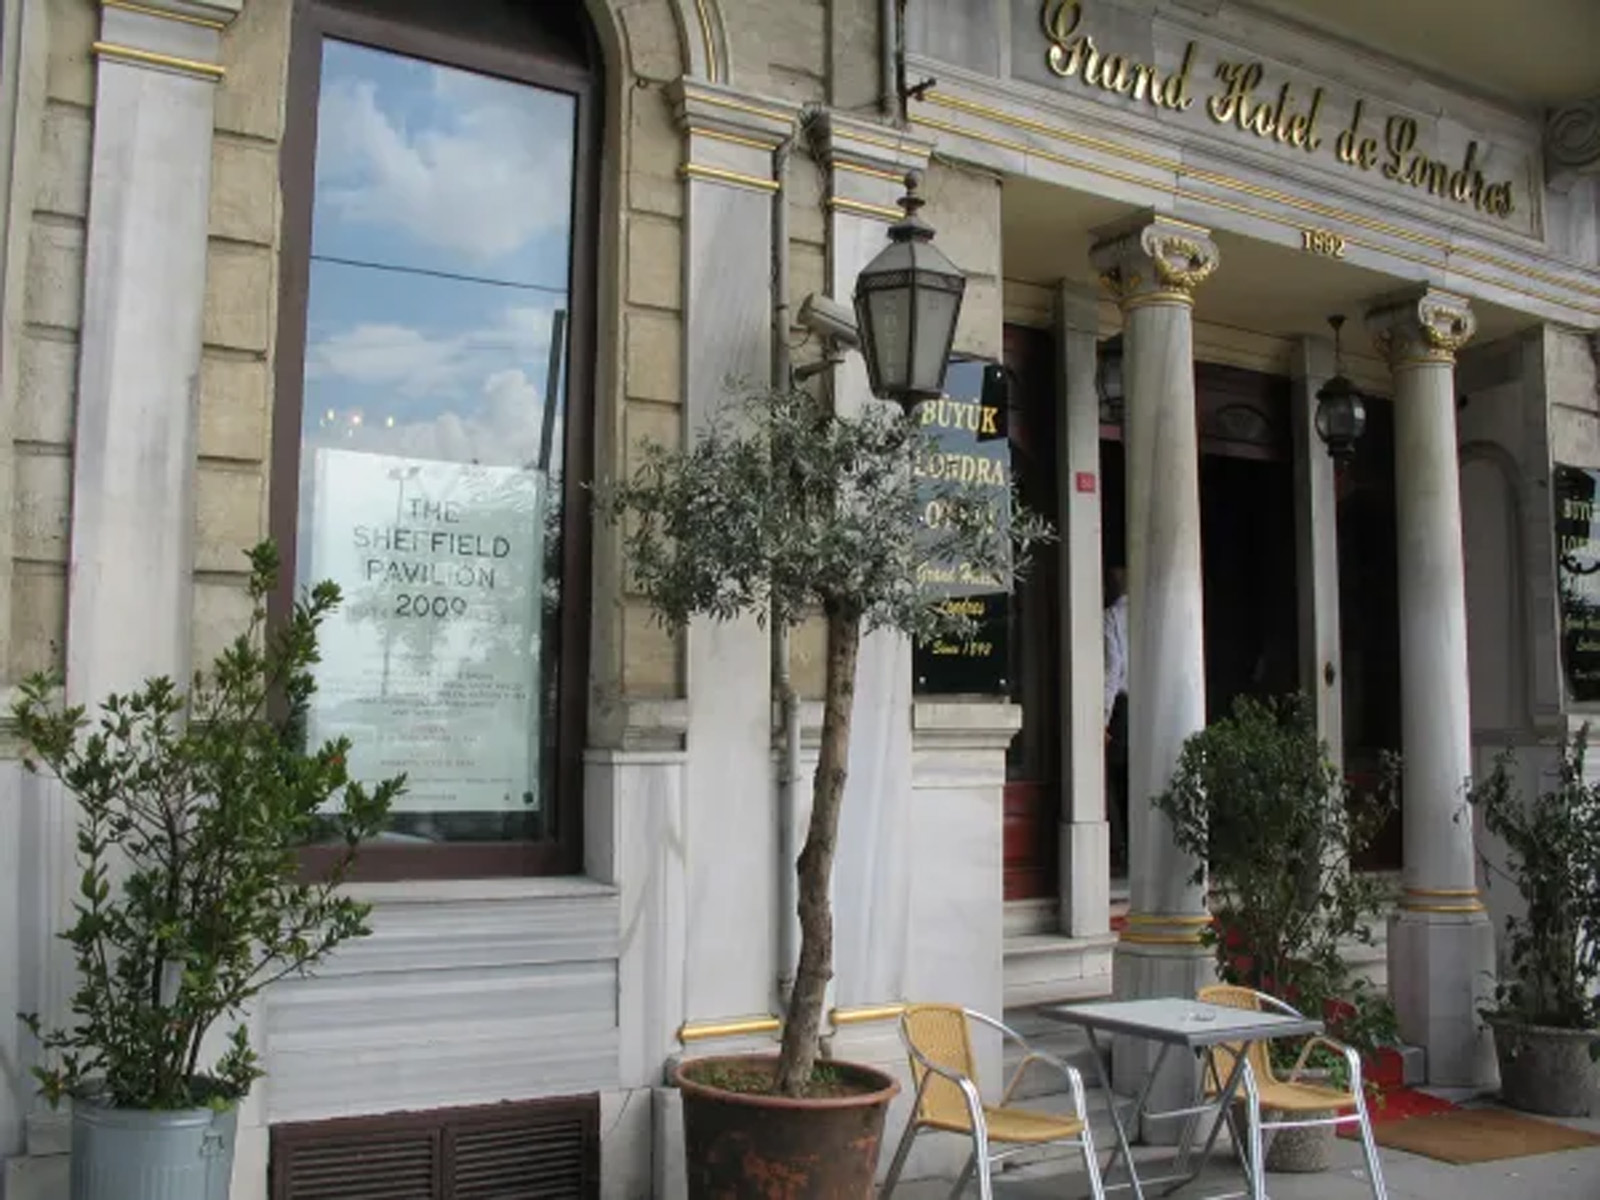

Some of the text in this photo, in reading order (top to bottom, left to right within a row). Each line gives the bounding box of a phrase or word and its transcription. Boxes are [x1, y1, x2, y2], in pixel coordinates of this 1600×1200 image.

[1039, 0, 1515, 210] Grand Hotel de Londres
[1301, 230, 1345, 257] 1892
[409, 499, 460, 523] THE
[353, 524, 510, 558] SHEFFIELD
[366, 559, 495, 589] PAVILION
[395, 594, 467, 618] 2009
